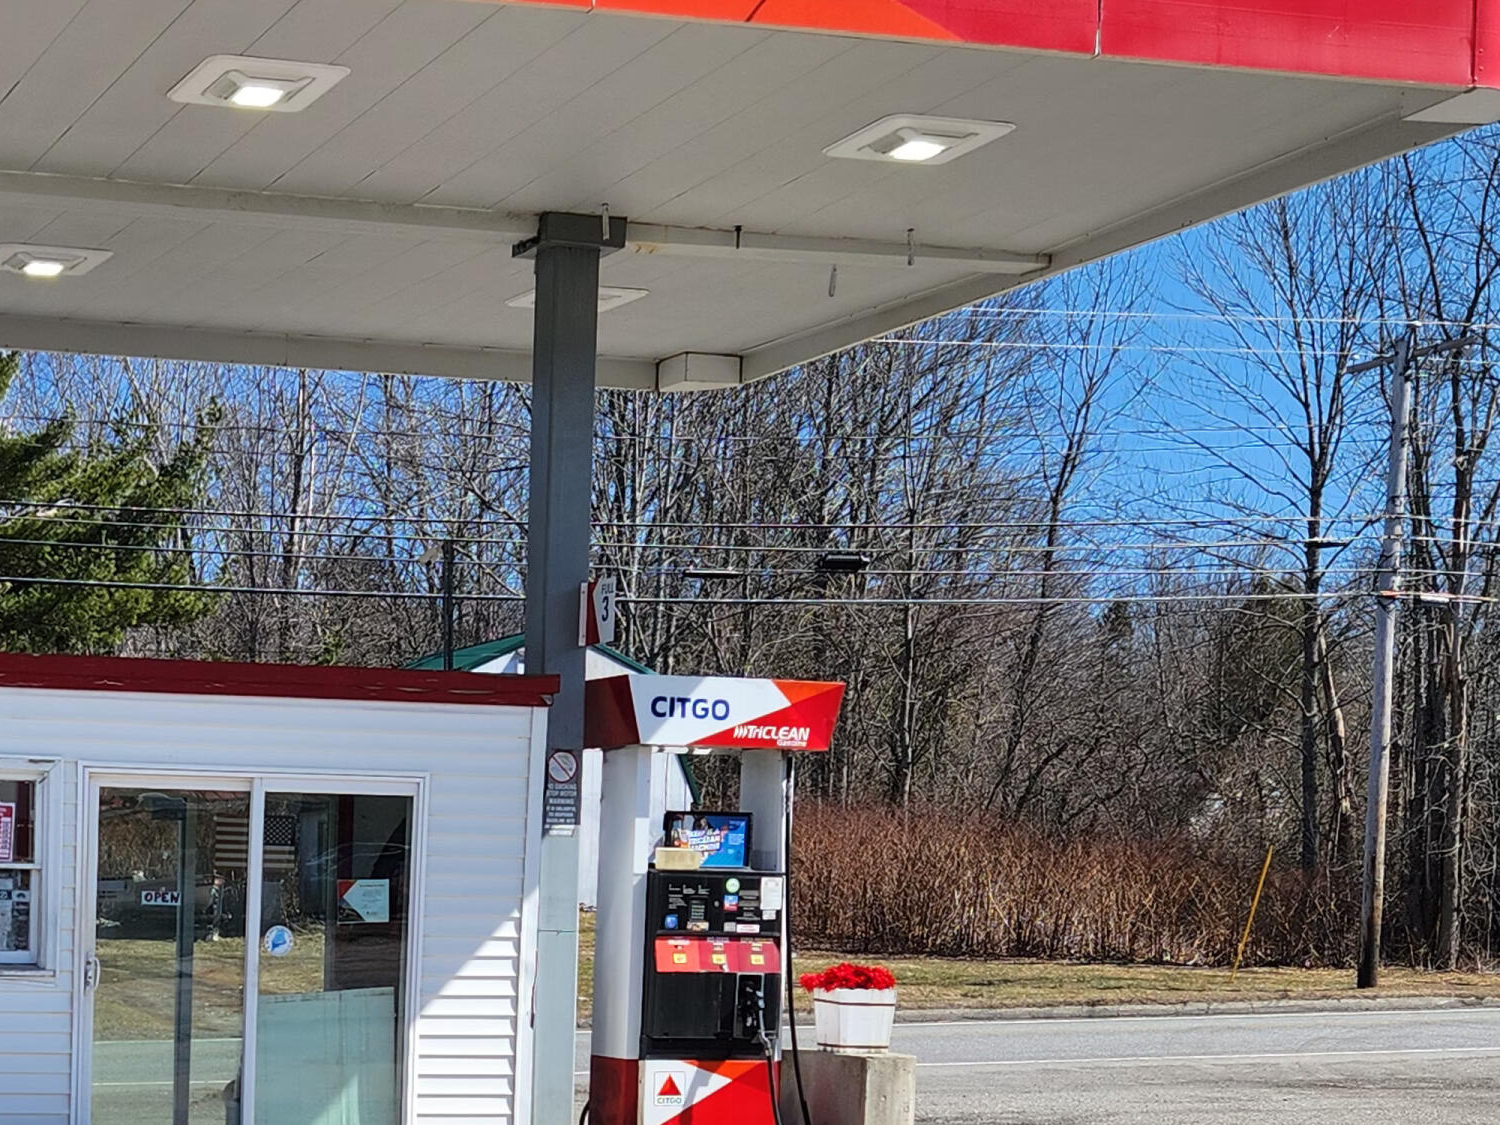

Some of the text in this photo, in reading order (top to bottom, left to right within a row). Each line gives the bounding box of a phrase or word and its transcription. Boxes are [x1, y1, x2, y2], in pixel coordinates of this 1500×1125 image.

[601, 583, 614, 594] FULL
[601, 596, 609, 622] 3
[650, 696, 730, 721] CITGO
[143, 892, 180, 904] OPEN
[657, 1097, 682, 1105] CITGO
